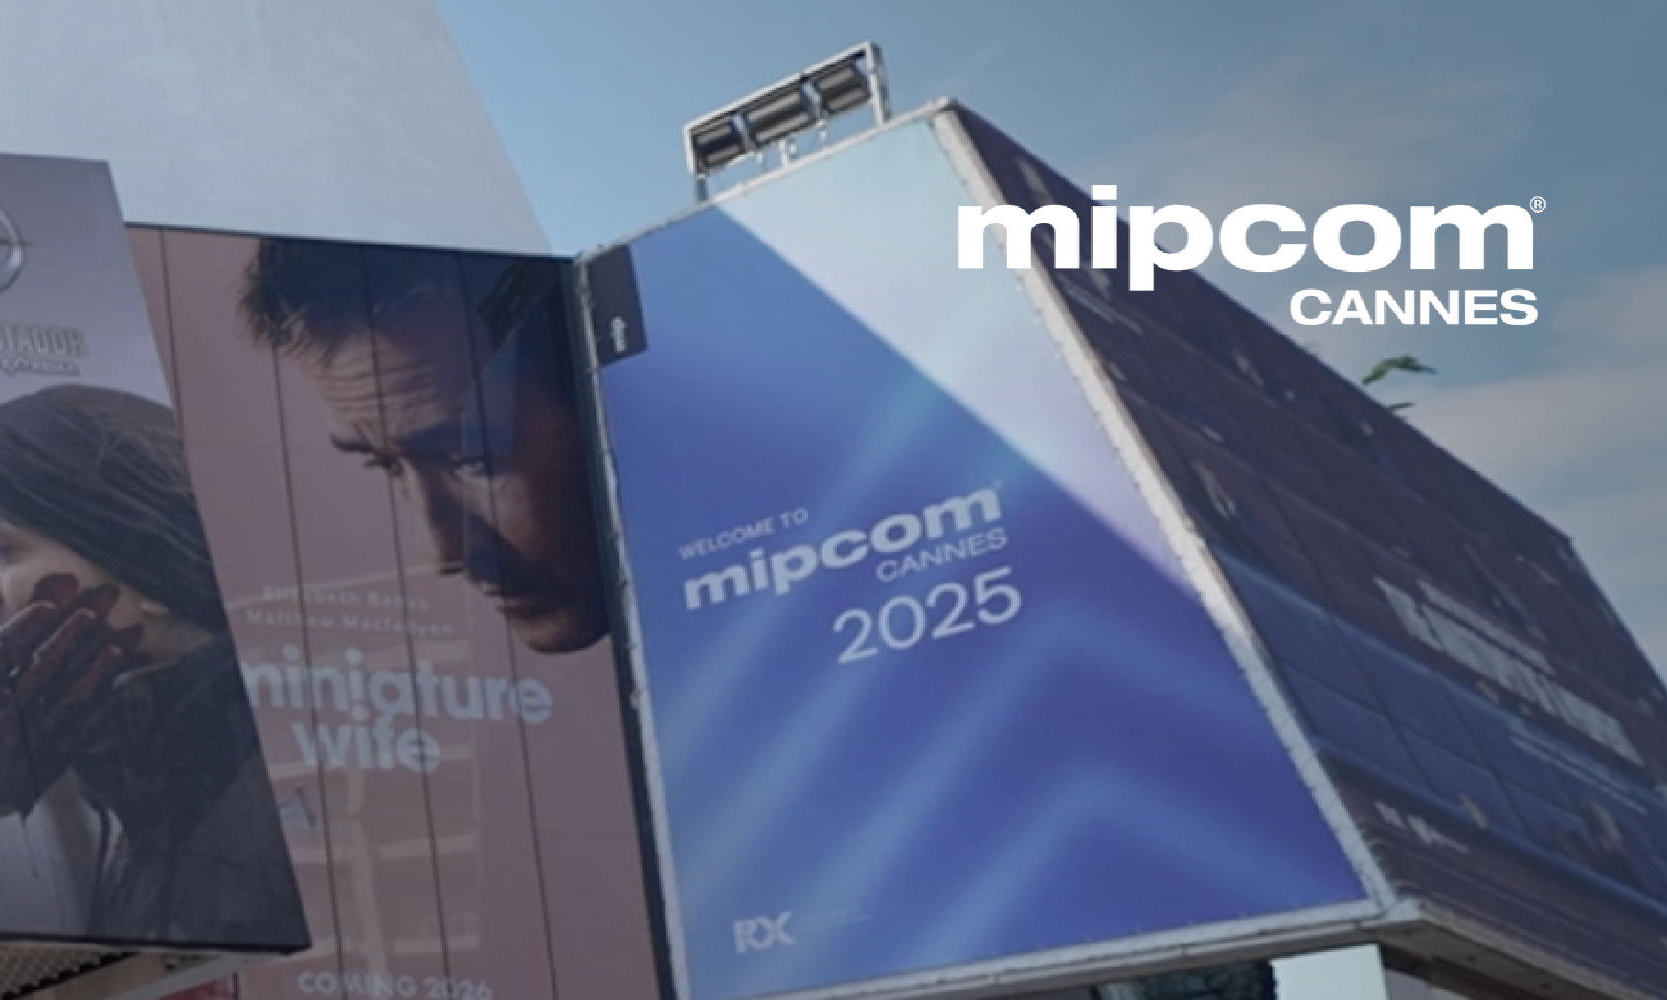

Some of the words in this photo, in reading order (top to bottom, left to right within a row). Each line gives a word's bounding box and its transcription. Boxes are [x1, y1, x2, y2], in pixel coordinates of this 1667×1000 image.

[678, 512, 777, 561] WELCOME
[779, 506, 810, 530] TO
[683, 487, 1003, 611] mipcom
[875, 526, 1009, 583] CANNES
[832, 565, 1022, 665] 2025
[297, 970, 418, 998] COMING
